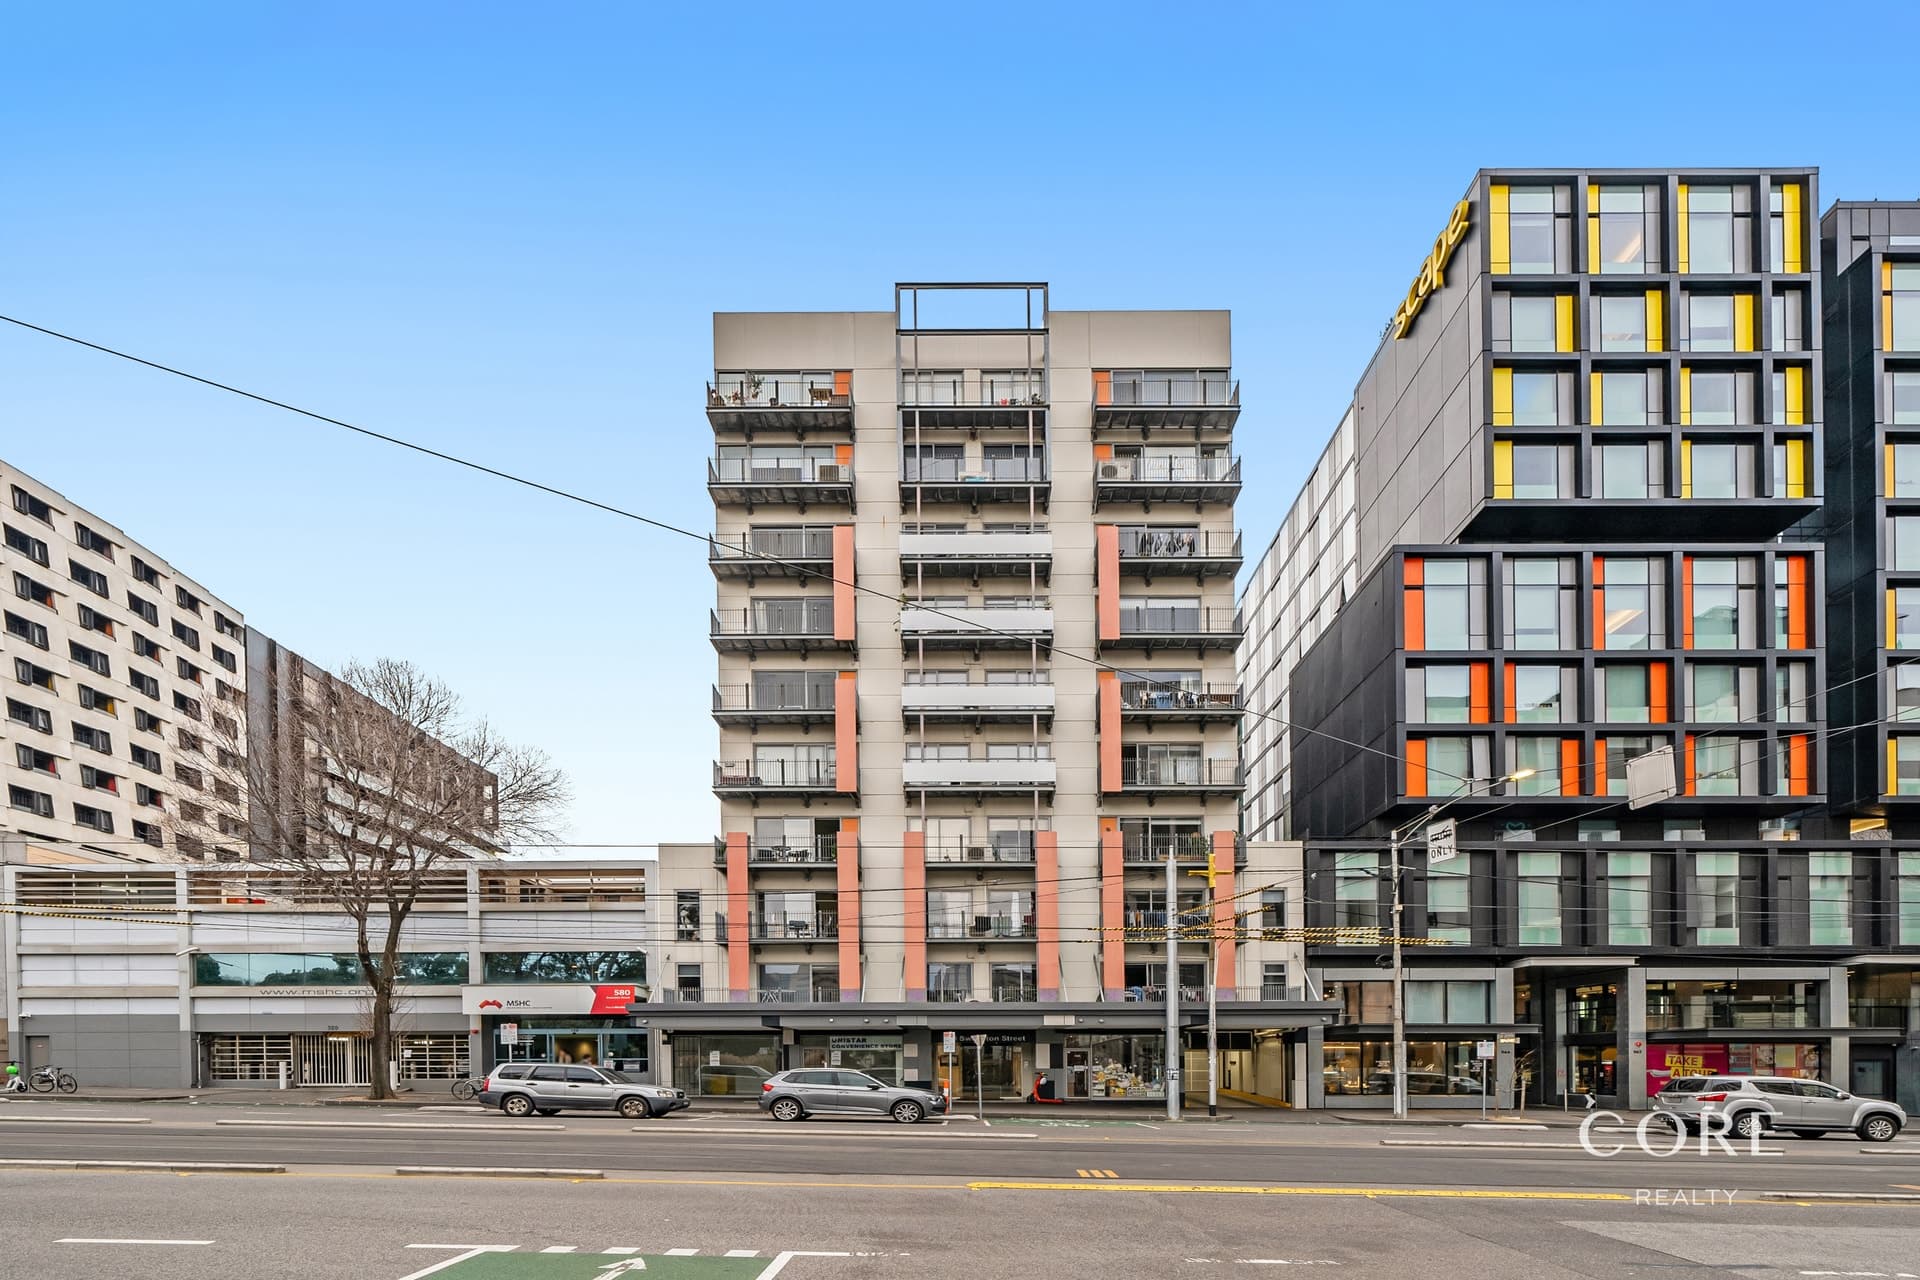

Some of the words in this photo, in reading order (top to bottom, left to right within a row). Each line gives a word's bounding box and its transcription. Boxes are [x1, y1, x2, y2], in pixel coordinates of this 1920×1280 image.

[1393, 199, 1469, 341] scape
[1431, 845, 1453, 859] ONLY
[259, 988, 398, 996] www.mshc.org
[1668, 1055, 1698, 1066] TAKE
[1672, 1068, 1681, 1078] A
